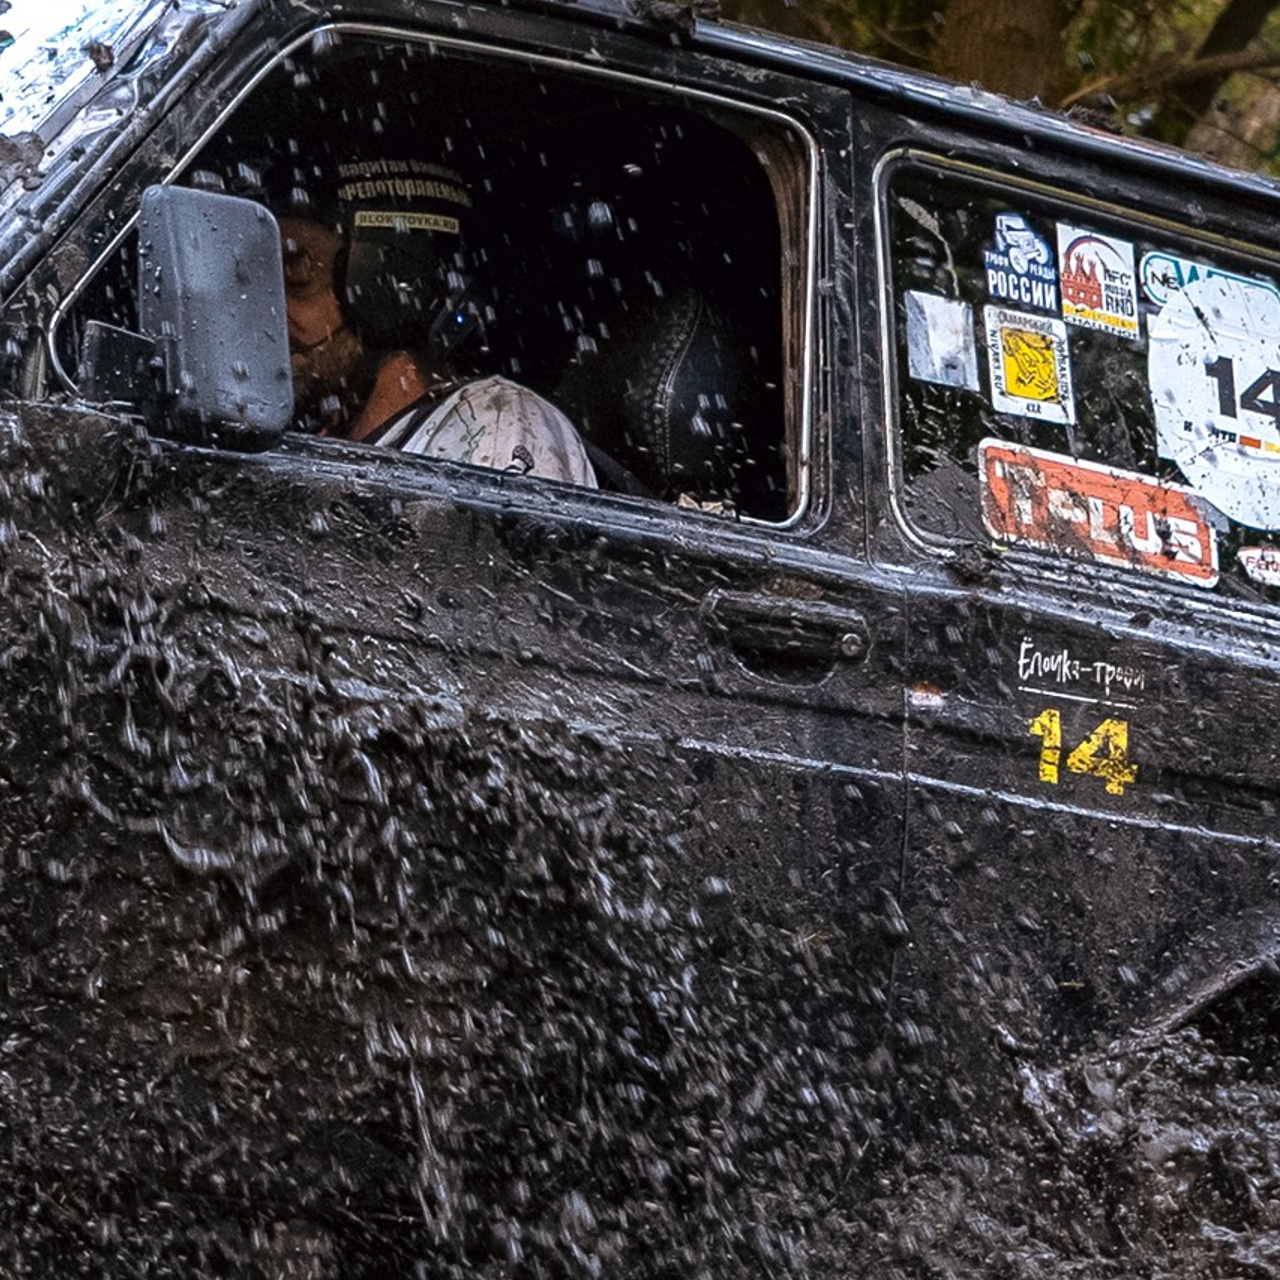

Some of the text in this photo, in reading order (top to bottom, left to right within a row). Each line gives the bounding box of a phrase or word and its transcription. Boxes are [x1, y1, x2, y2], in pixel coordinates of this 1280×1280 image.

[987, 268, 1056, 311] РОССИИ
[1205, 355, 1280, 433] 14
[1029, 708, 1138, 795] 14
